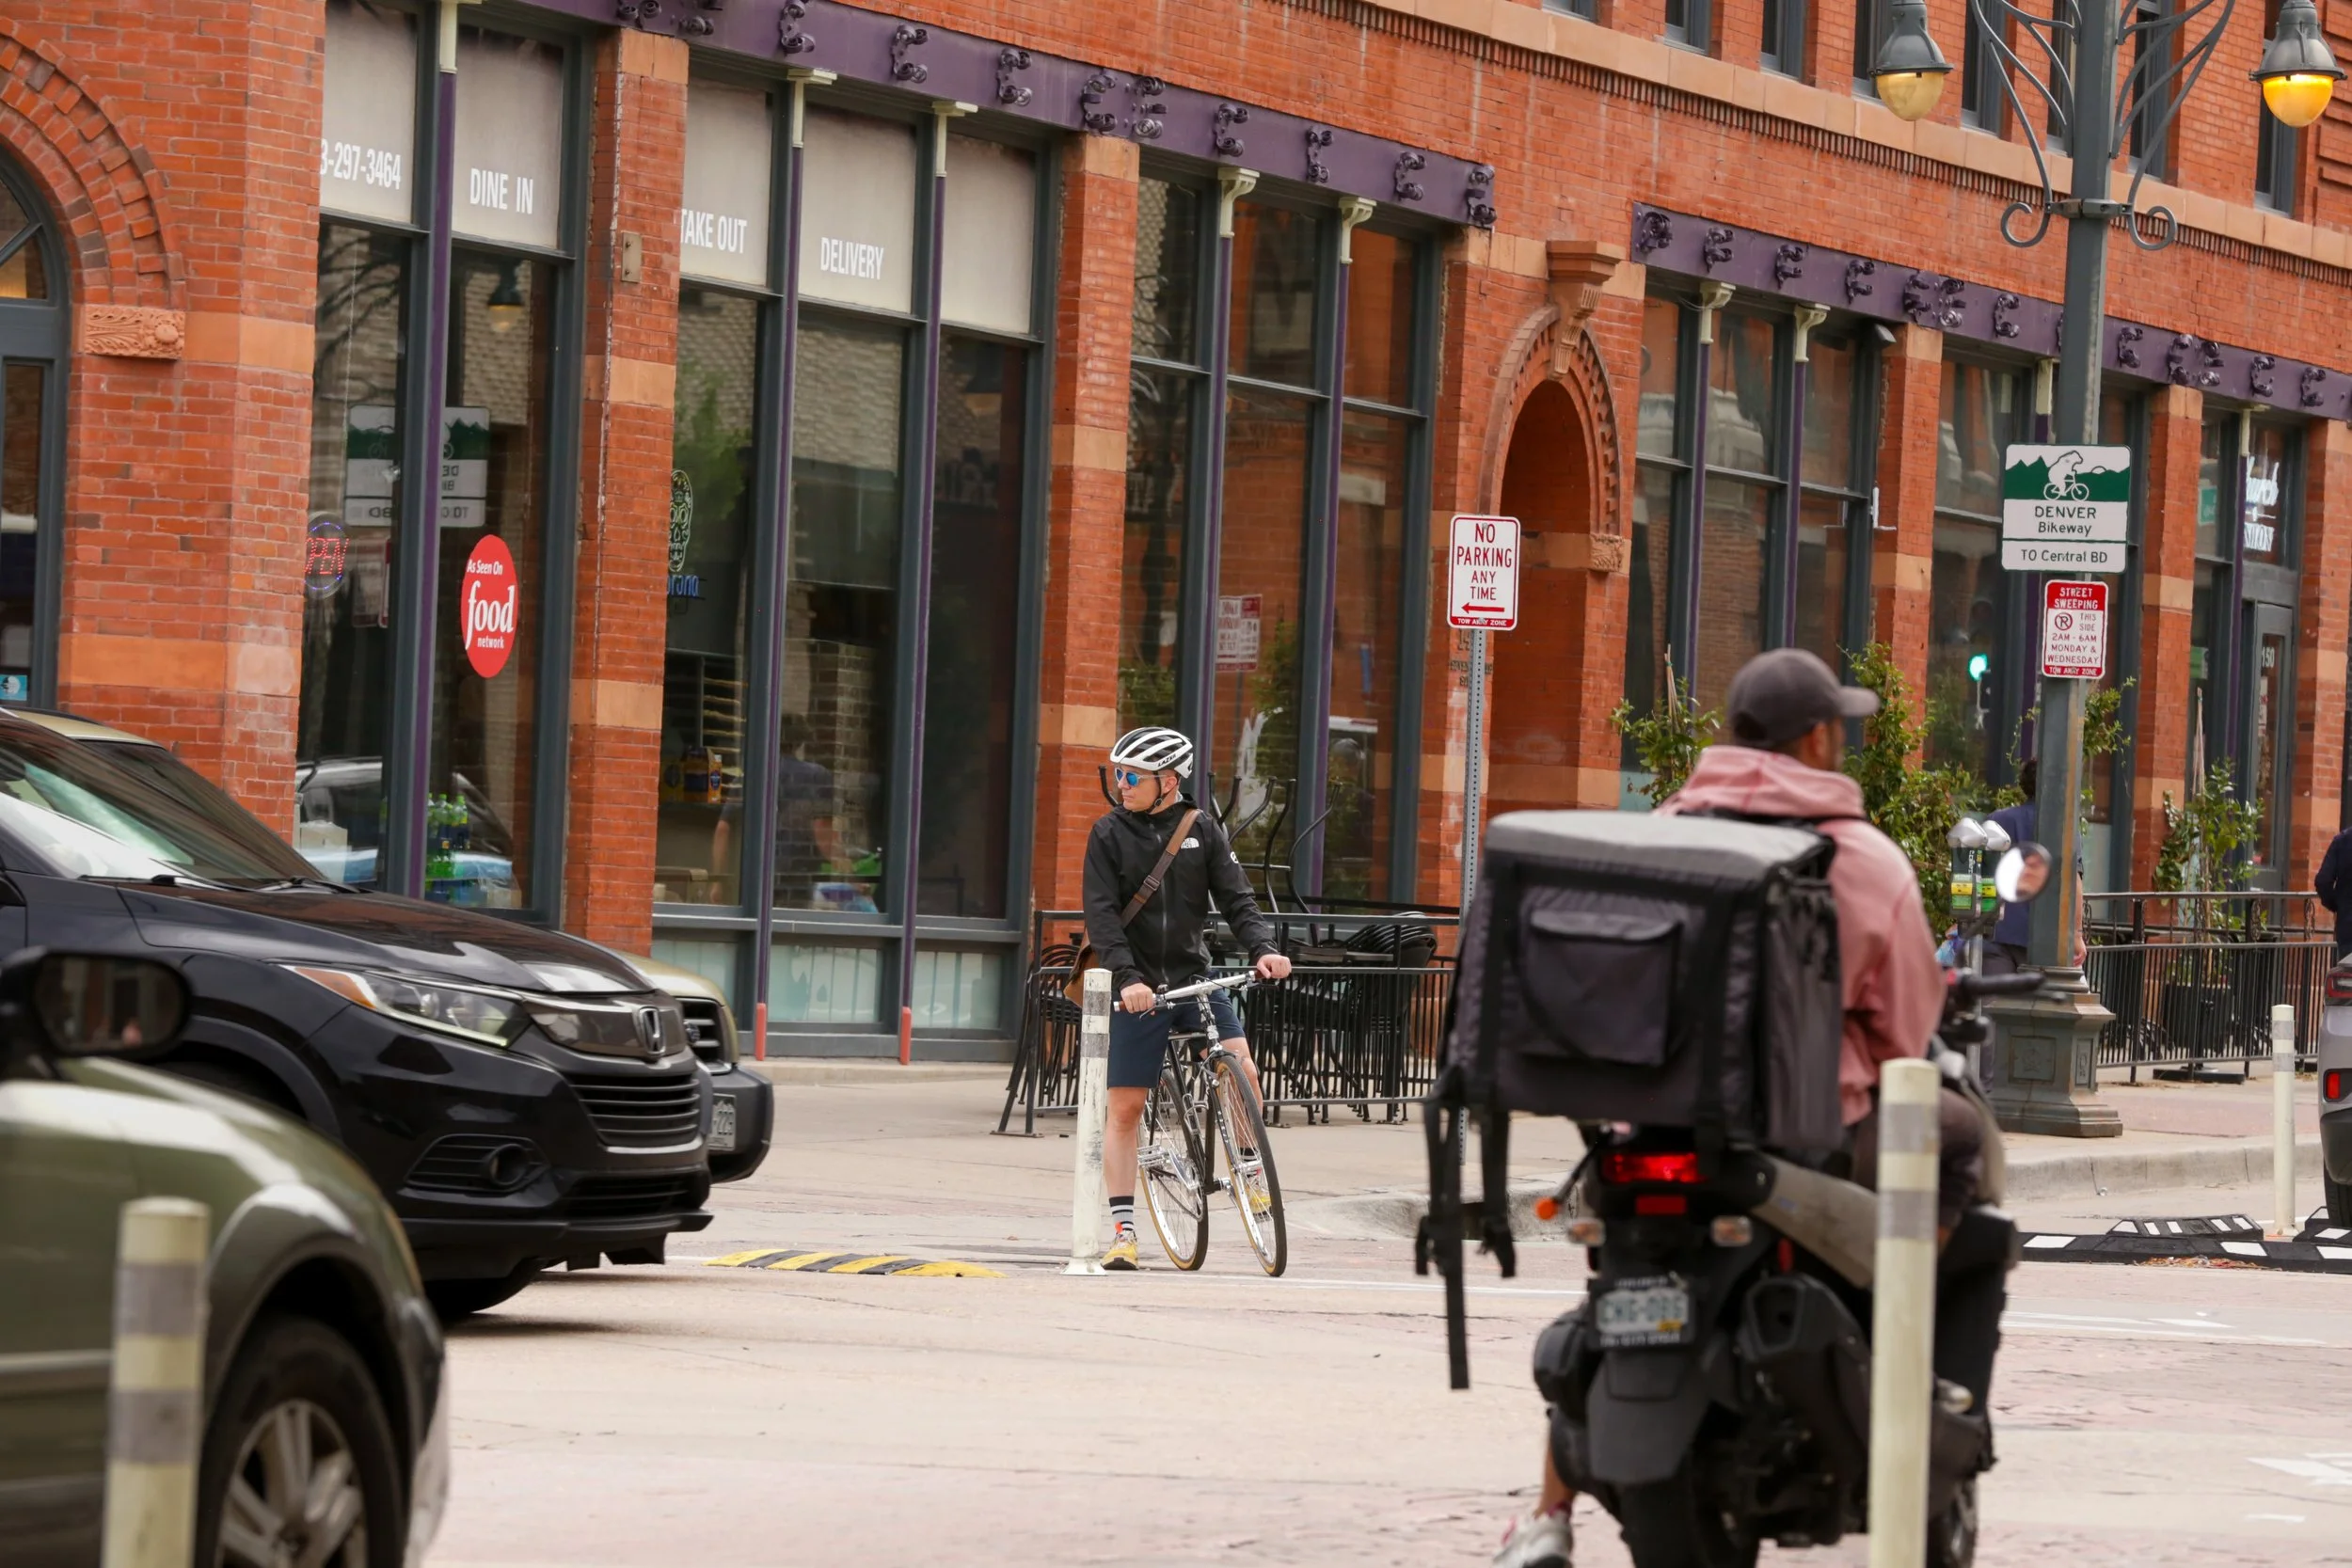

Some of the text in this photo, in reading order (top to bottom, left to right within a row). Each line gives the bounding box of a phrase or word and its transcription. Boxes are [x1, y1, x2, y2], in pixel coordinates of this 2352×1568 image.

[320, 137, 402, 190] 3-297-3464
[469, 167, 533, 214] DINE IN
[681, 208, 748, 254] TAKE OUT
[820, 236, 884, 280] DELIVERY
[2034, 505, 2096, 519] DENVER
[1474, 522, 1496, 544] NO
[2038, 521, 2091, 537] Bikeway
[1456, 546, 1513, 568] PARKING
[2021, 548, 2108, 563] TO Central BD
[467, 558, 503, 576] As Seen On
[1470, 570, 1497, 584] ANY
[1470, 586, 1497, 601] TIME
[2059, 586, 2093, 598] STREET
[2054, 597, 2099, 610] SWEEPING
[465, 579, 516, 651] food
[2080, 612, 2096, 621] THIS
[477, 636, 504, 650] network
[2052, 632, 2070, 641] 2AM
[2078, 634, 2097, 642] 6AM
[2051, 643, 2087, 654] MONDAY
[2047, 654, 2099, 664] WEDNESDAY
